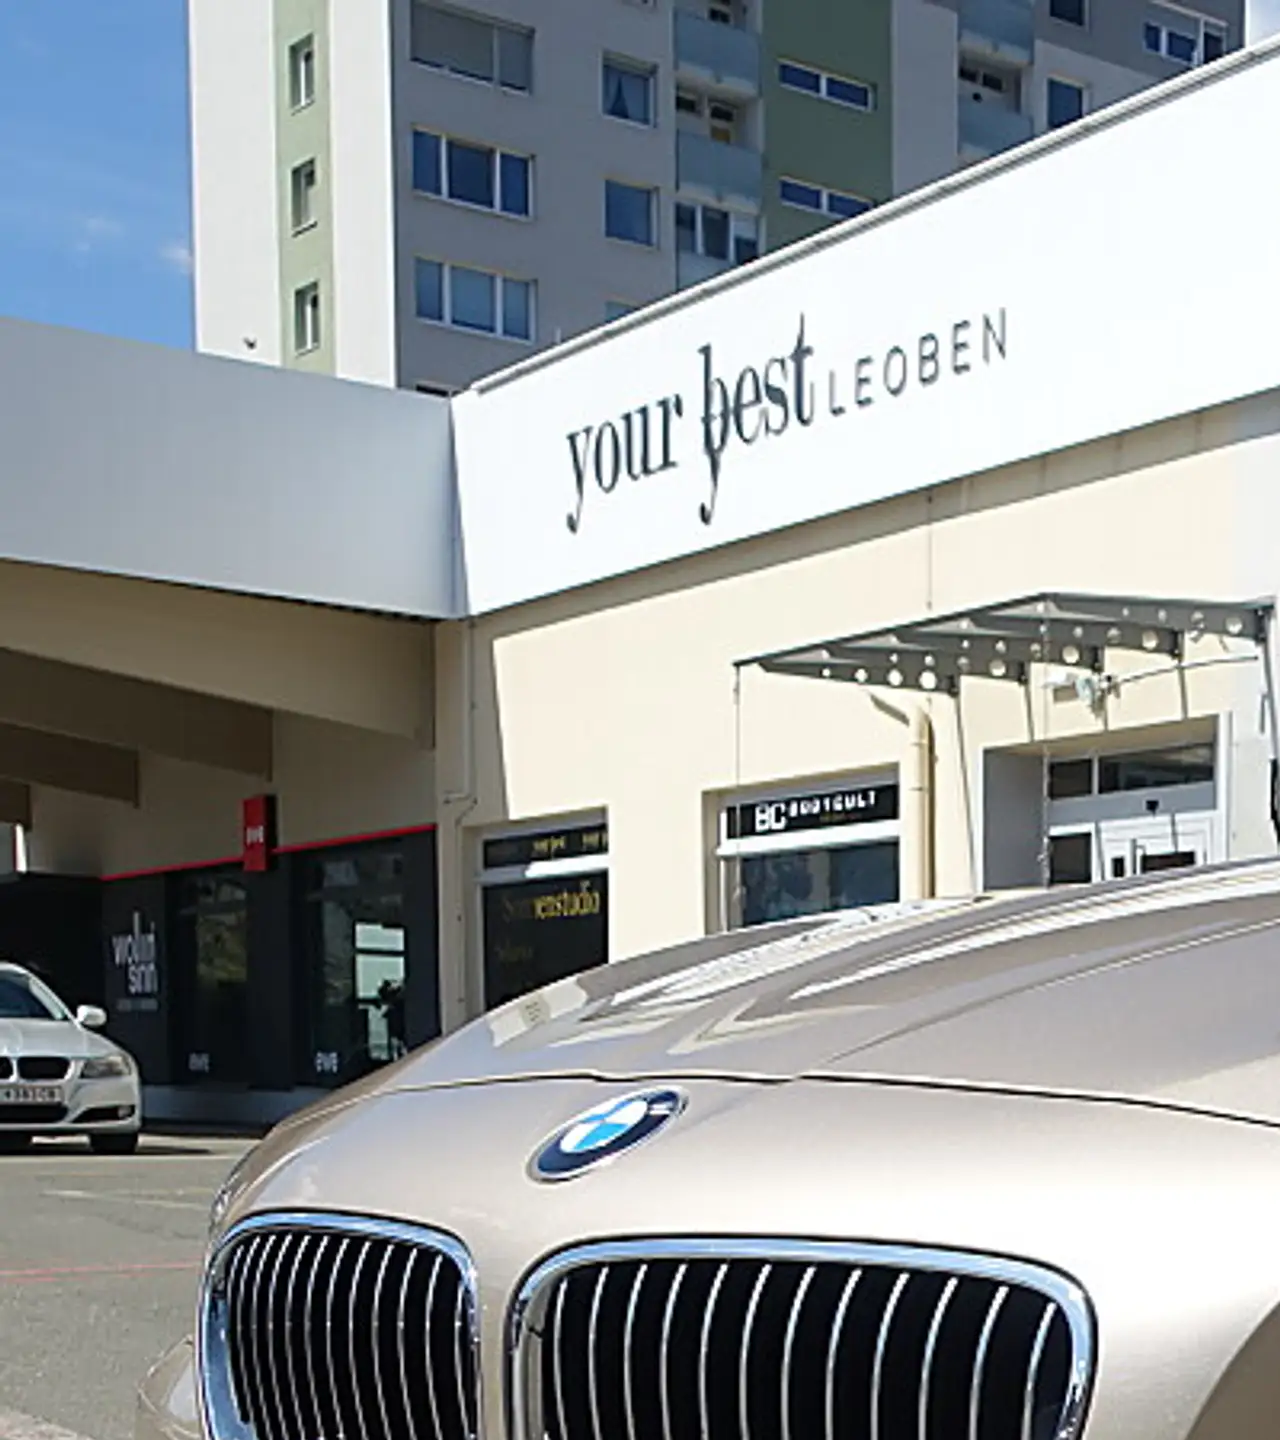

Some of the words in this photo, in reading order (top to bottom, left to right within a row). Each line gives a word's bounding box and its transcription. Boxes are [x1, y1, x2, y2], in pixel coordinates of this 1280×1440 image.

[566, 393, 683, 534] your
[698, 311, 813, 526] best
[828, 306, 1008, 418] LEOBEN
